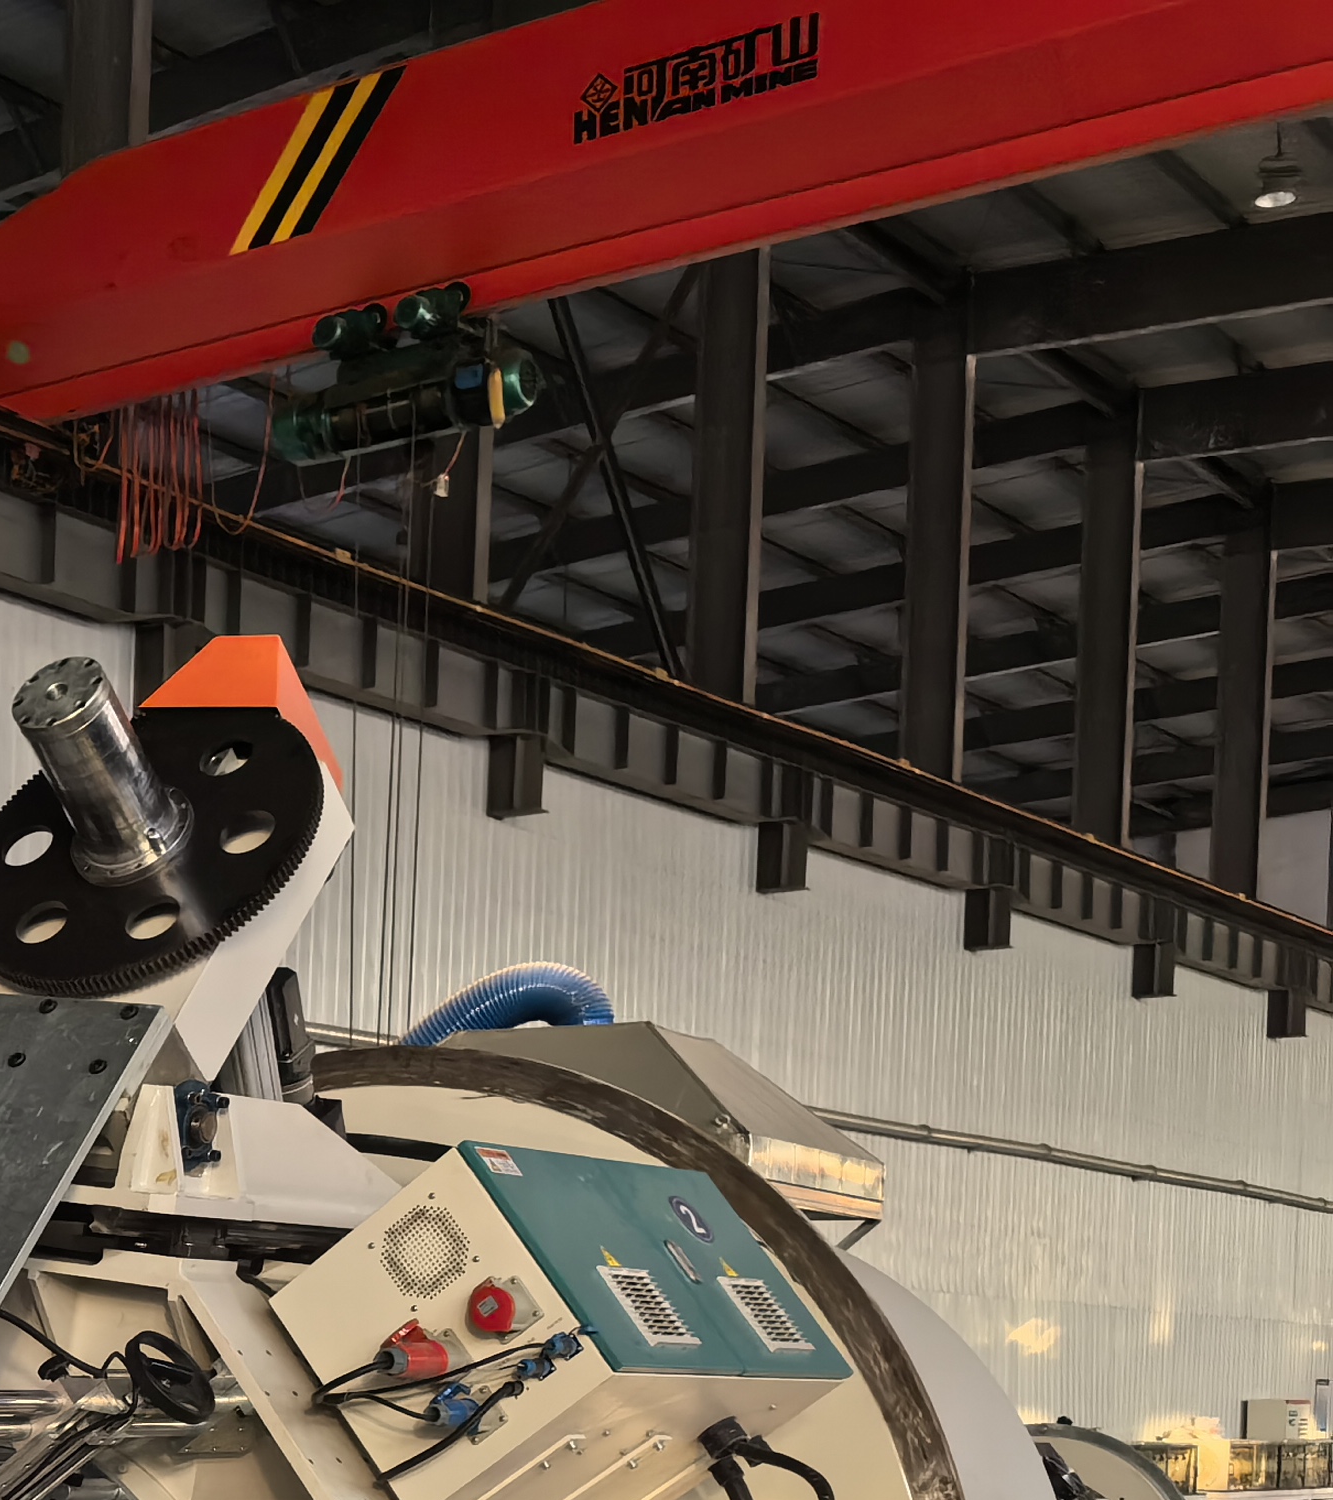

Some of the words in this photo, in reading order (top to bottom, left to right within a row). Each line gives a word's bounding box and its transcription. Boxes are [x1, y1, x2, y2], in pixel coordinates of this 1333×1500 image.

[573, 90, 716, 145] HENAN
[720, 58, 819, 104] MINE
[623, 12, 820, 108] 河南矿山
[679, 1204, 707, 1234] 2
